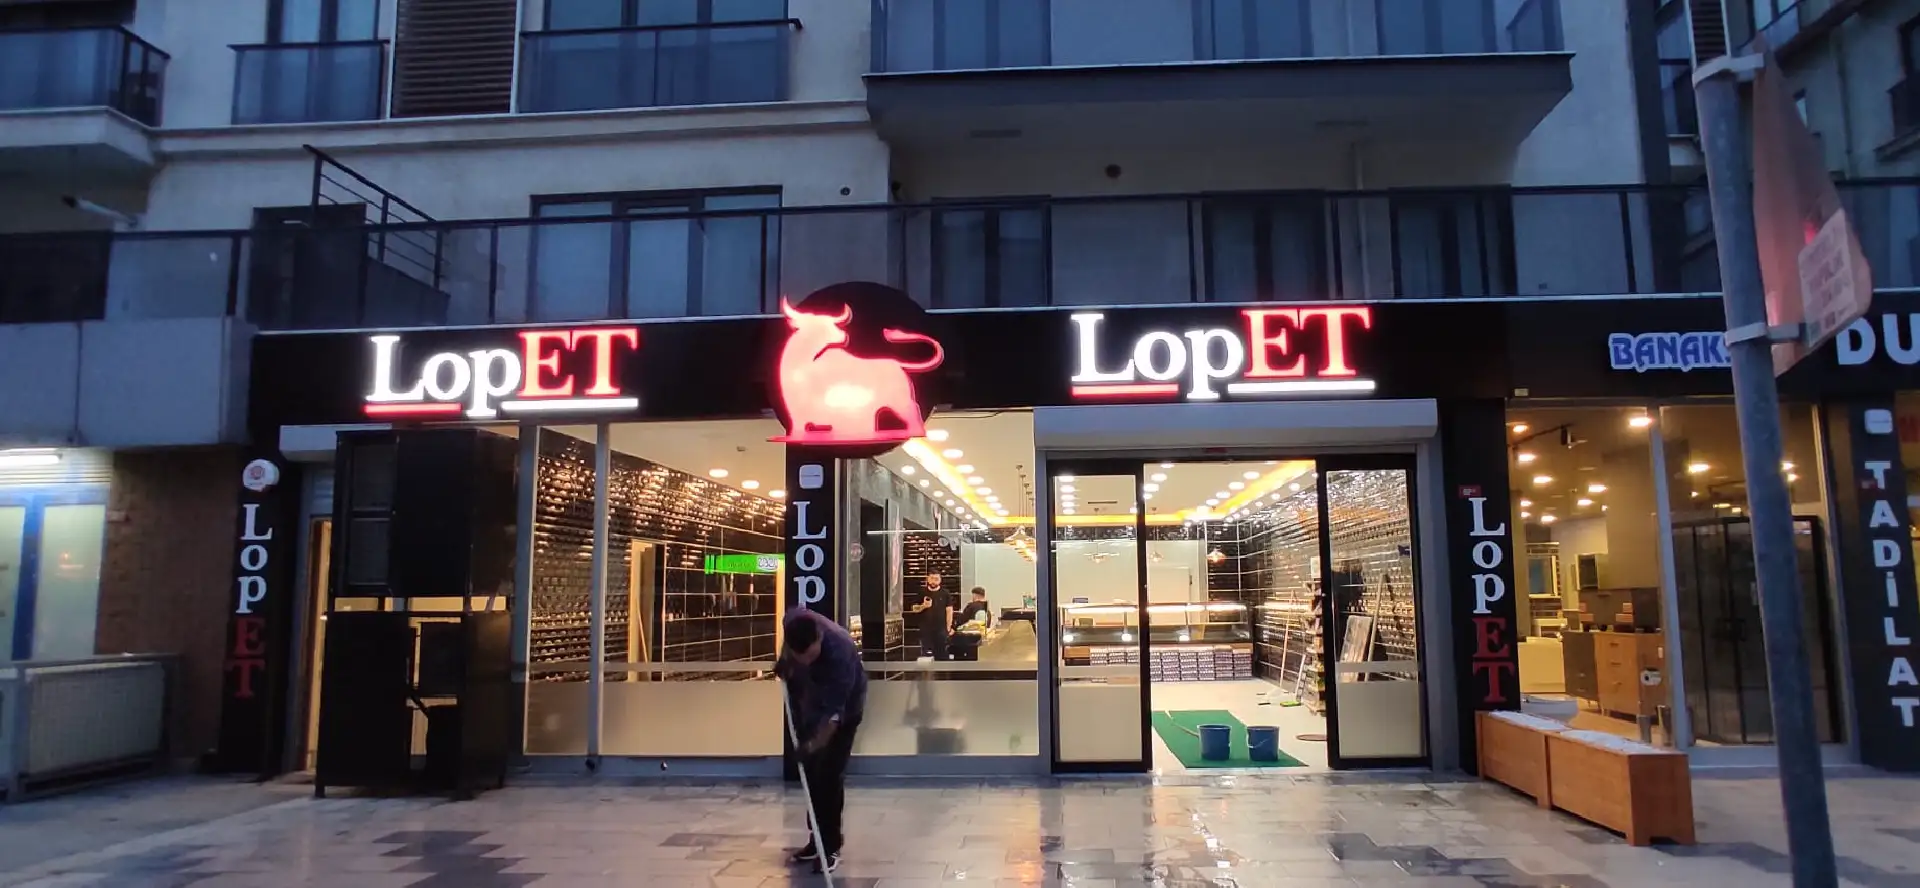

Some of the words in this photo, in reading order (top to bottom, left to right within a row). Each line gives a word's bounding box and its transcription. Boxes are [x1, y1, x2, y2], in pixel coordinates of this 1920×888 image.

[366, 328, 639, 417] LopET
[1070, 306, 1370, 399] LopET
[1610, 334, 1732, 369] BANAK
[225, 503, 273, 698] LopET
[792, 501, 827, 609] Lop
[1469, 497, 1515, 703] LopET
[1864, 461, 1920, 727] TADİLAT
